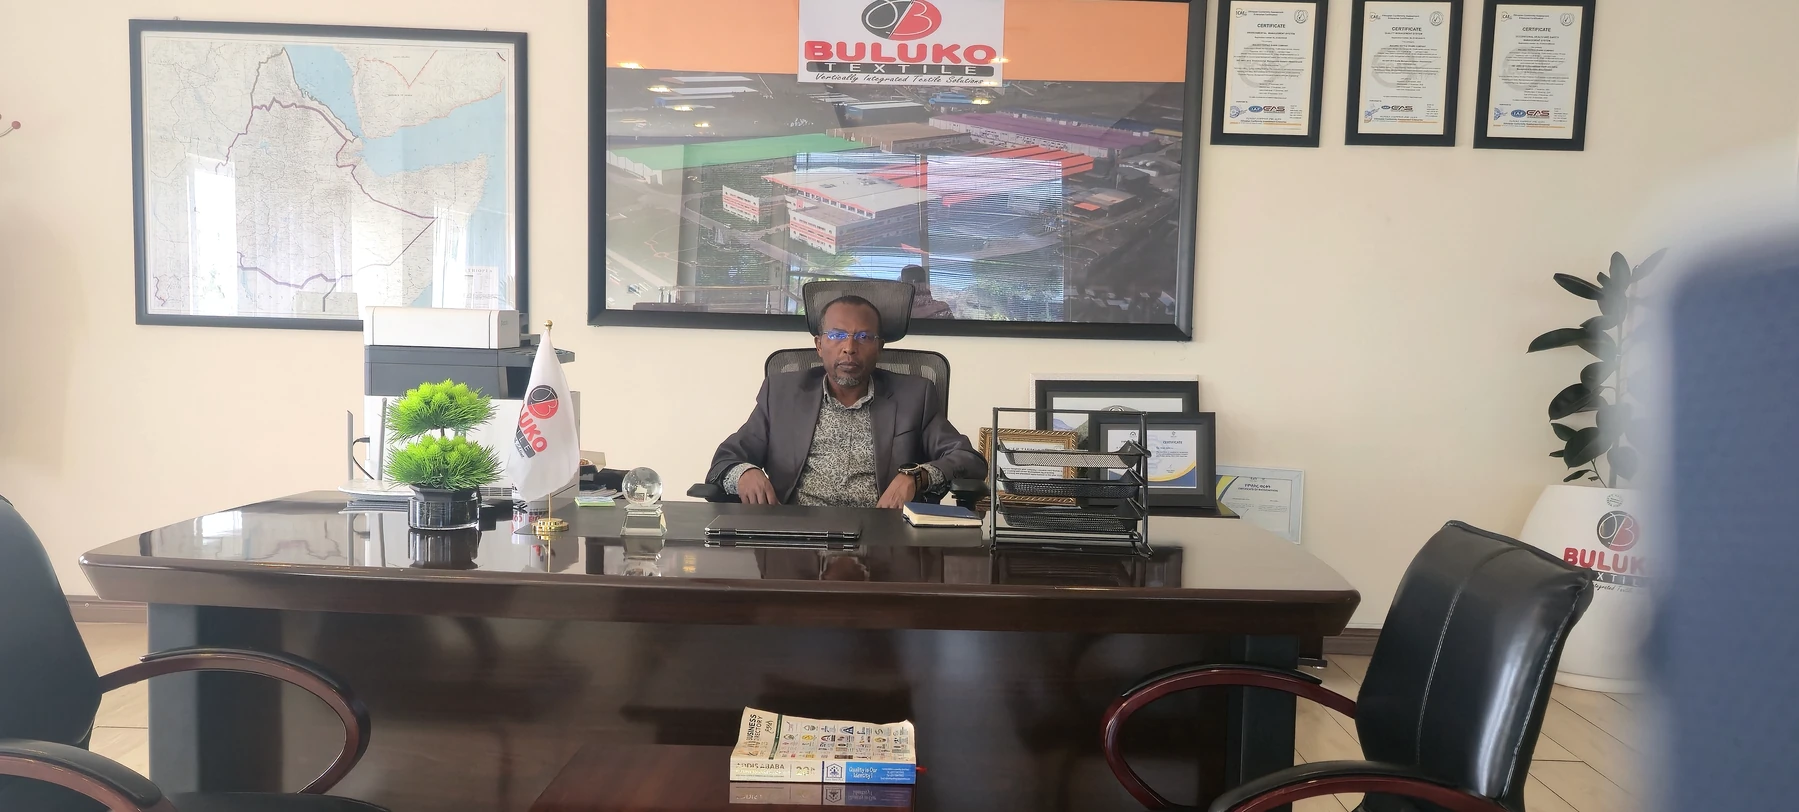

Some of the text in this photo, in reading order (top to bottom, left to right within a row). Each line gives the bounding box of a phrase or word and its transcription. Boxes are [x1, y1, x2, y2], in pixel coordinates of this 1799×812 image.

[804, 41, 997, 65] BULUKO
[824, 62, 977, 75] TEXTILE
[815, 72, 984, 85] Vertically Integrated Textile Solutions
